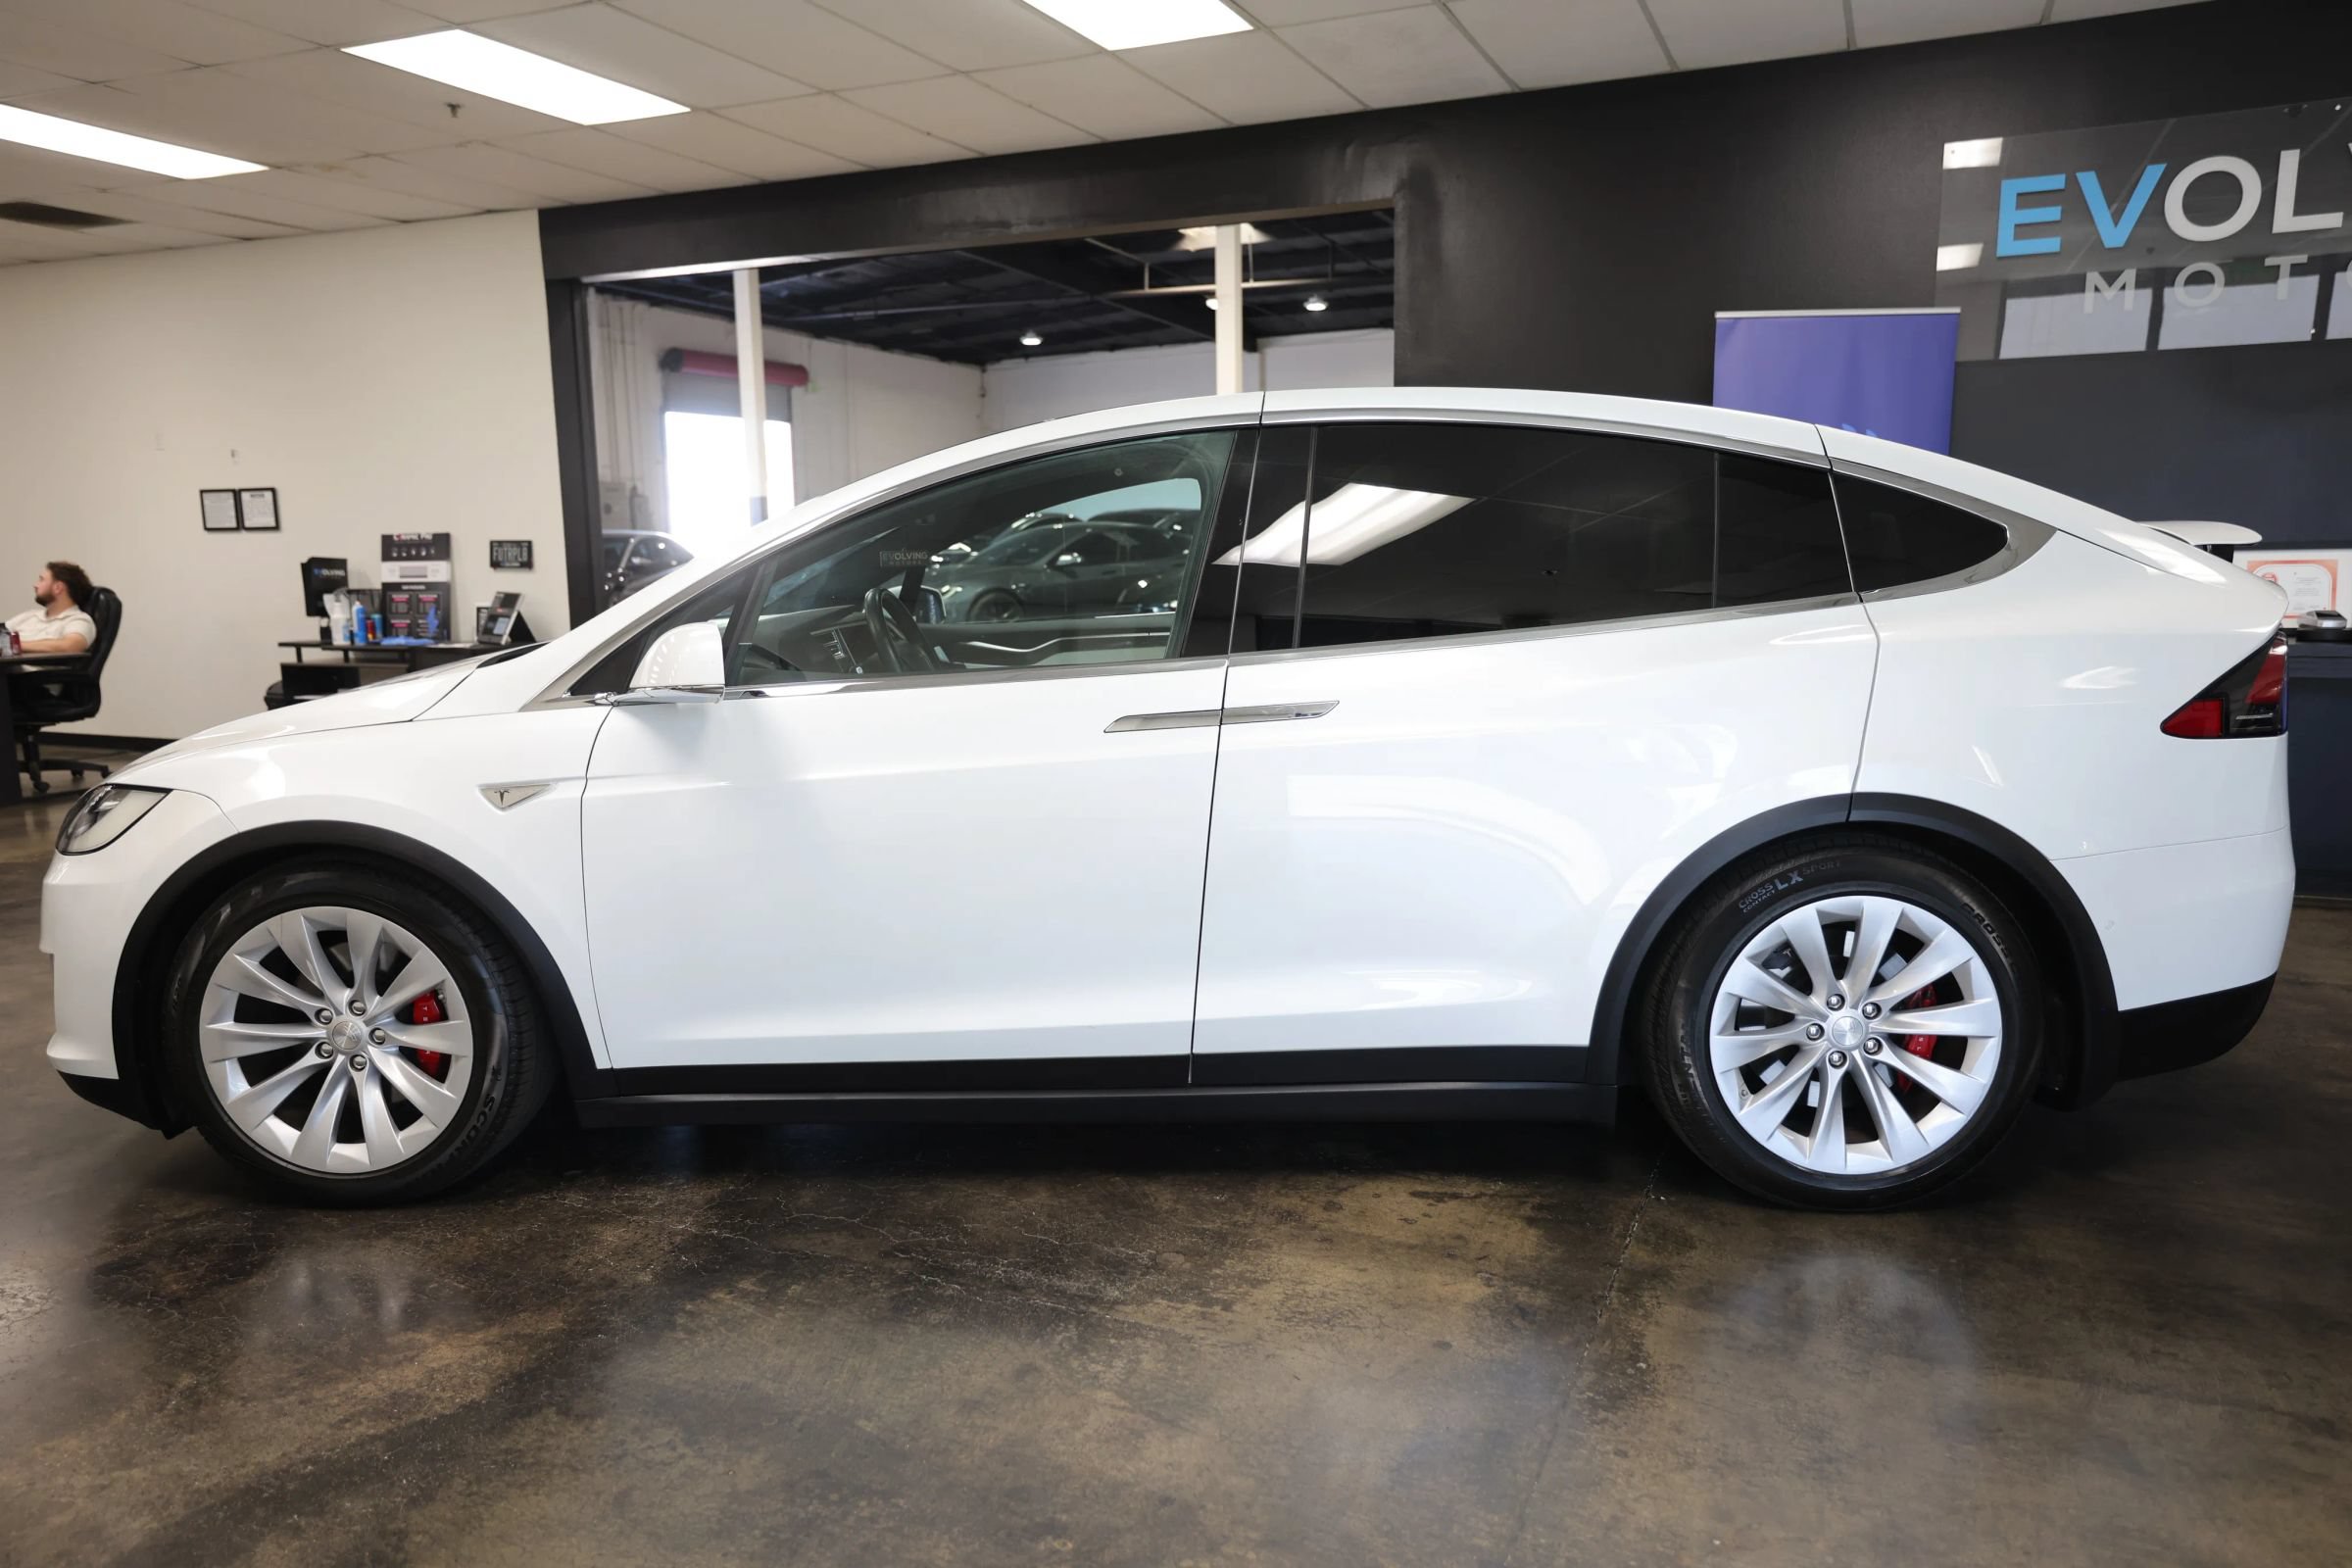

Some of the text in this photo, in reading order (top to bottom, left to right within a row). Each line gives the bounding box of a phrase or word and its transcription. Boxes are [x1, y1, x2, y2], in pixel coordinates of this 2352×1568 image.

[1995, 142, 2352, 258] EVOL
[2083, 254, 2352, 315] MOT
[1739, 882, 1773, 909] CROSS
[1774, 870, 1804, 891] LX
[1742, 890, 1776, 913] CONTACT
